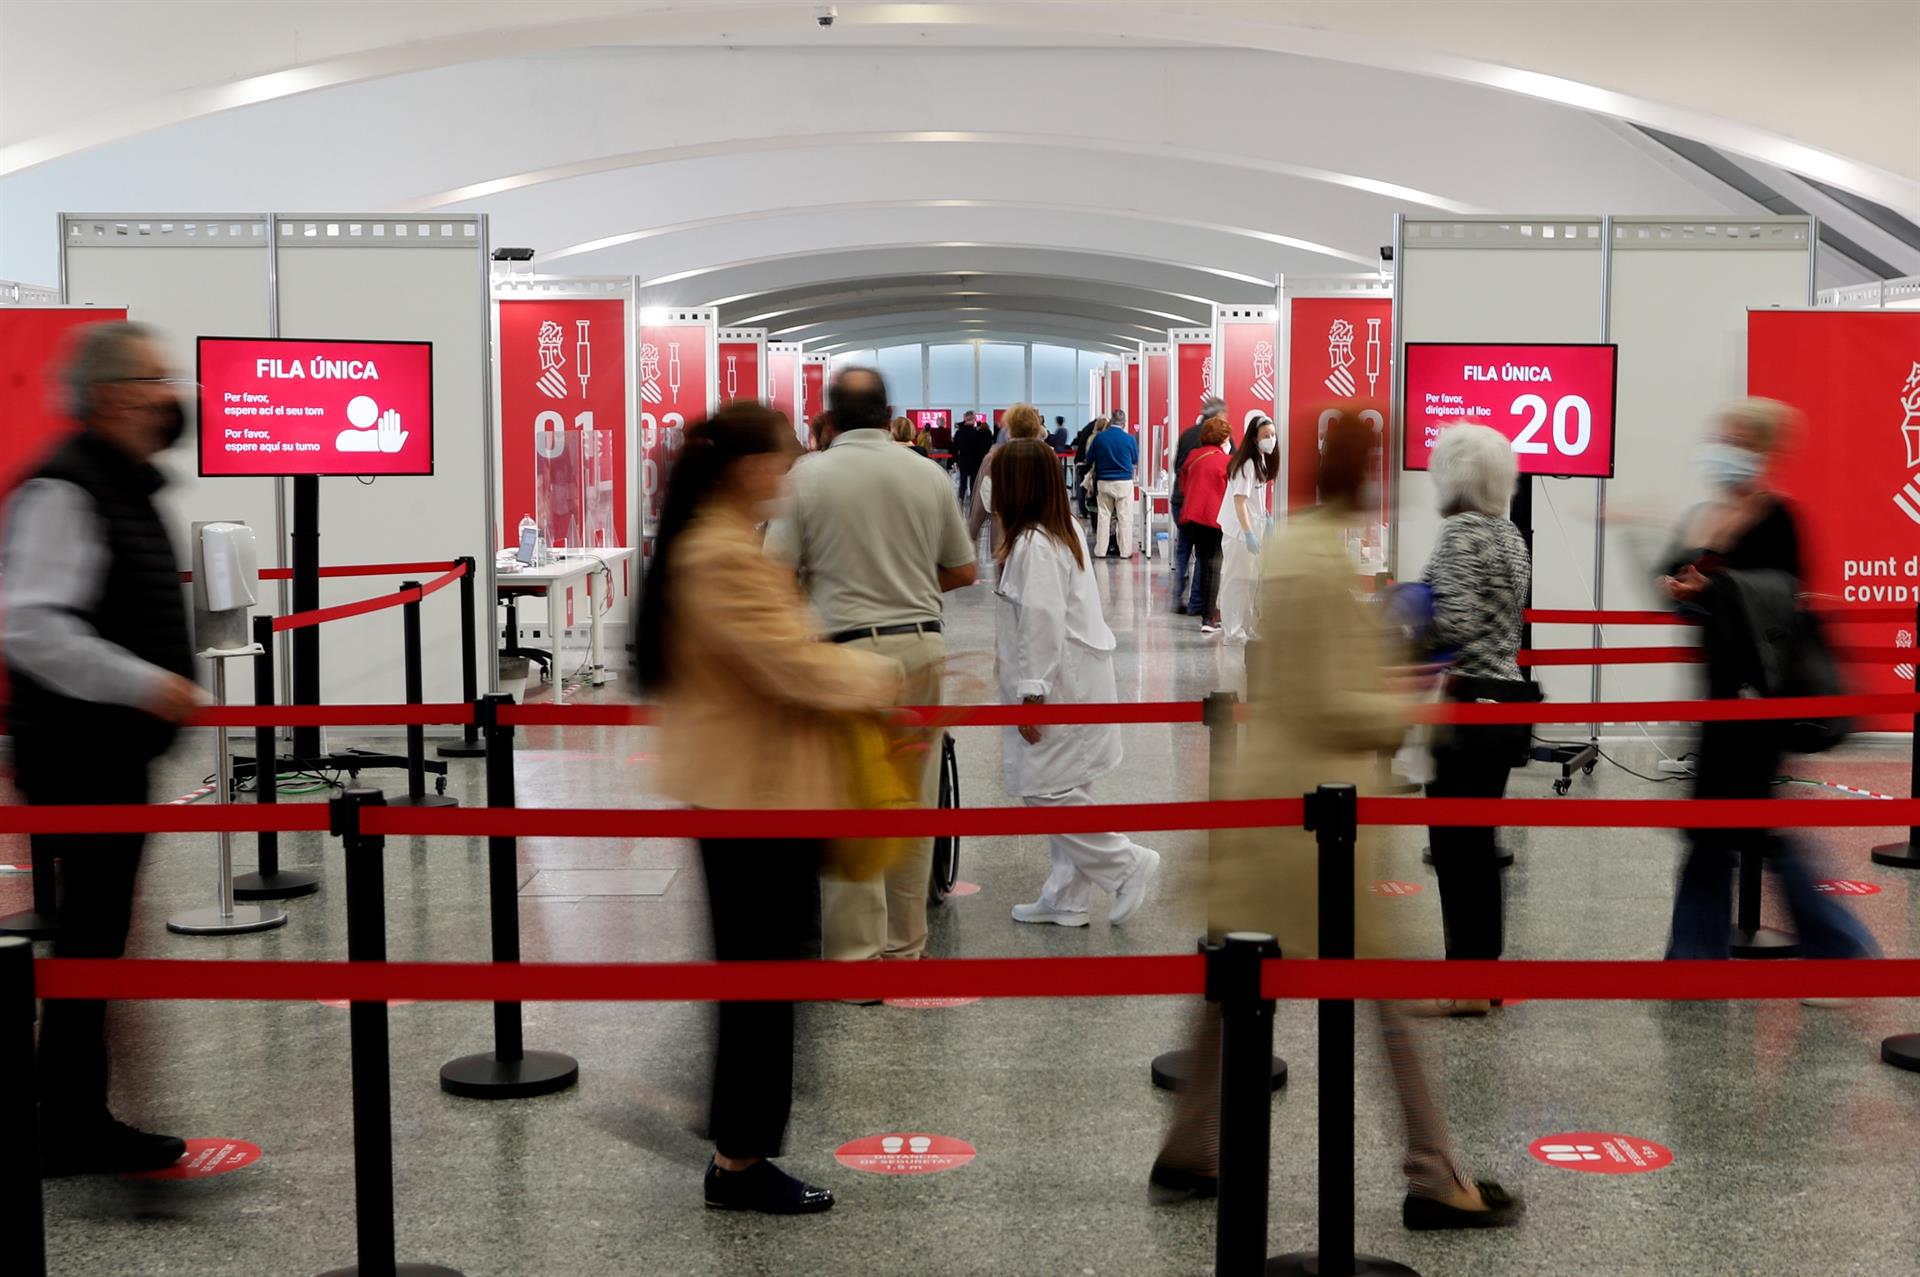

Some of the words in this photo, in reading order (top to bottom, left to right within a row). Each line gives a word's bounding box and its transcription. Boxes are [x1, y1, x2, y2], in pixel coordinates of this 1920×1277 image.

[256, 358, 306, 379] FILA
[310, 355, 379, 380] ÚNICA
[1463, 365, 1498, 381] FILA
[1501, 362, 1552, 382] ÚNICA
[224, 392, 242, 403] Per
[242, 392, 270, 404] favor,
[1425, 393, 1440, 403] Per
[1441, 393, 1464, 404] favor,
[224, 406, 258, 417] espere
[275, 405, 285, 416] el
[285, 407, 303, 416] seu
[1466, 405, 1475, 416] al
[1475, 406, 1492, 416] lloc
[1509, 393, 1592, 457] 20
[225, 428, 243, 439] Por
[243, 428, 271, 440] favor,
[534, 410, 595, 459] 01
[1425, 427, 1440, 437] Por
[225, 442, 258, 453] espere
[259, 441, 281, 453] aquí
[281, 443, 294, 452] su
[1844, 556, 1897, 581] punt
[1904, 555, 1920, 577] d
